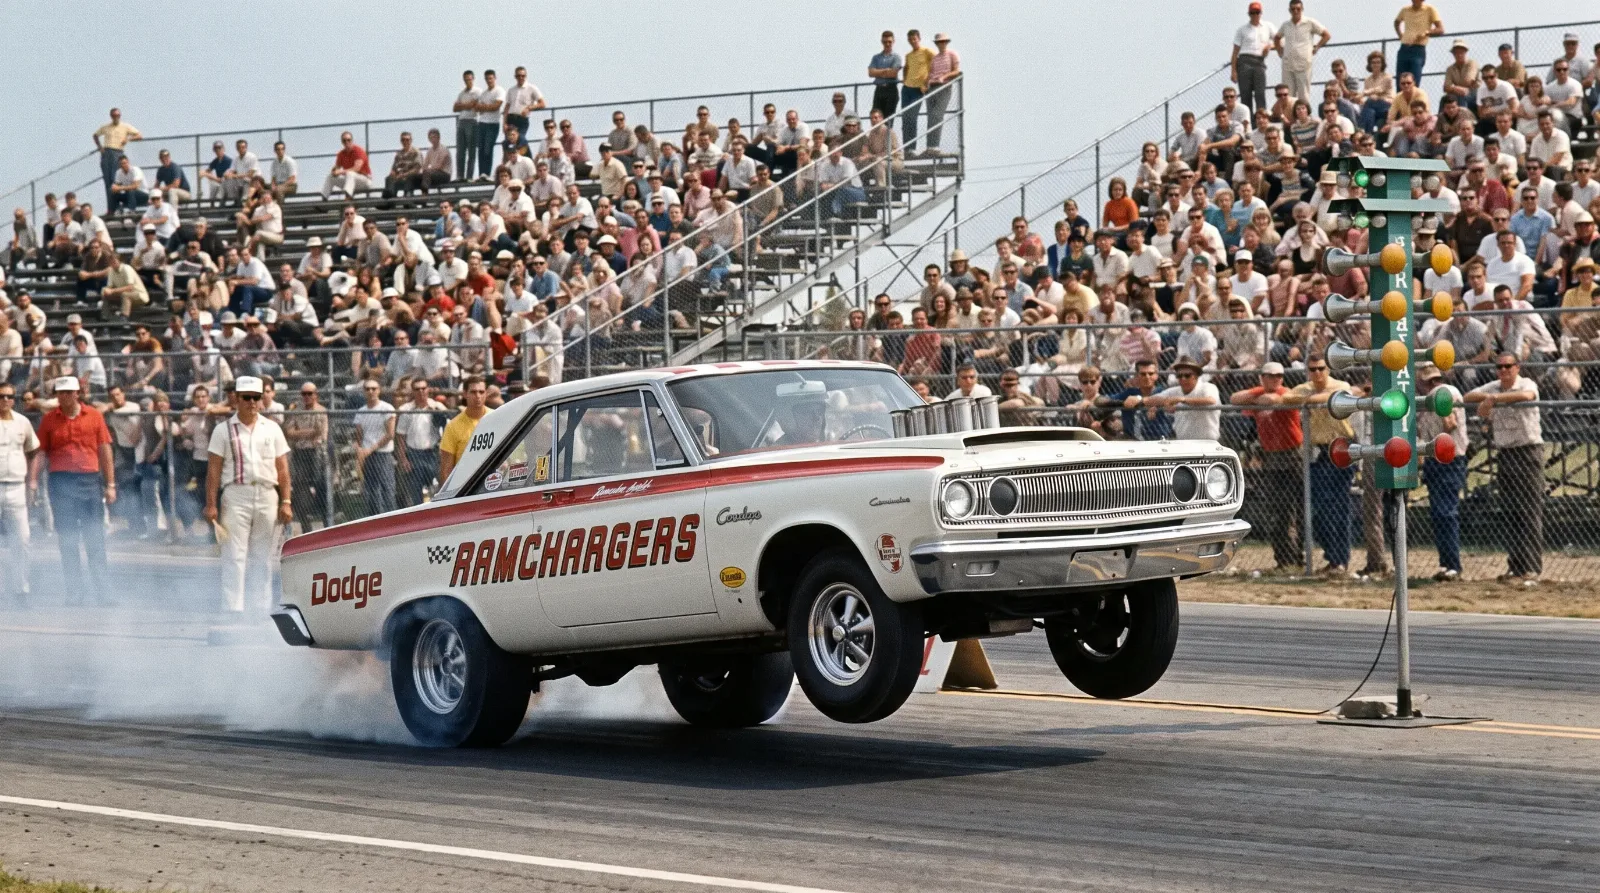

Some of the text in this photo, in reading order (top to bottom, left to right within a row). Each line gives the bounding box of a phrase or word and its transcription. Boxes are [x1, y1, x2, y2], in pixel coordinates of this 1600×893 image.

[469, 431, 495, 452] A990
[449, 513, 700, 587] RAMCHARGERS
[311, 566, 382, 609] Dodge
